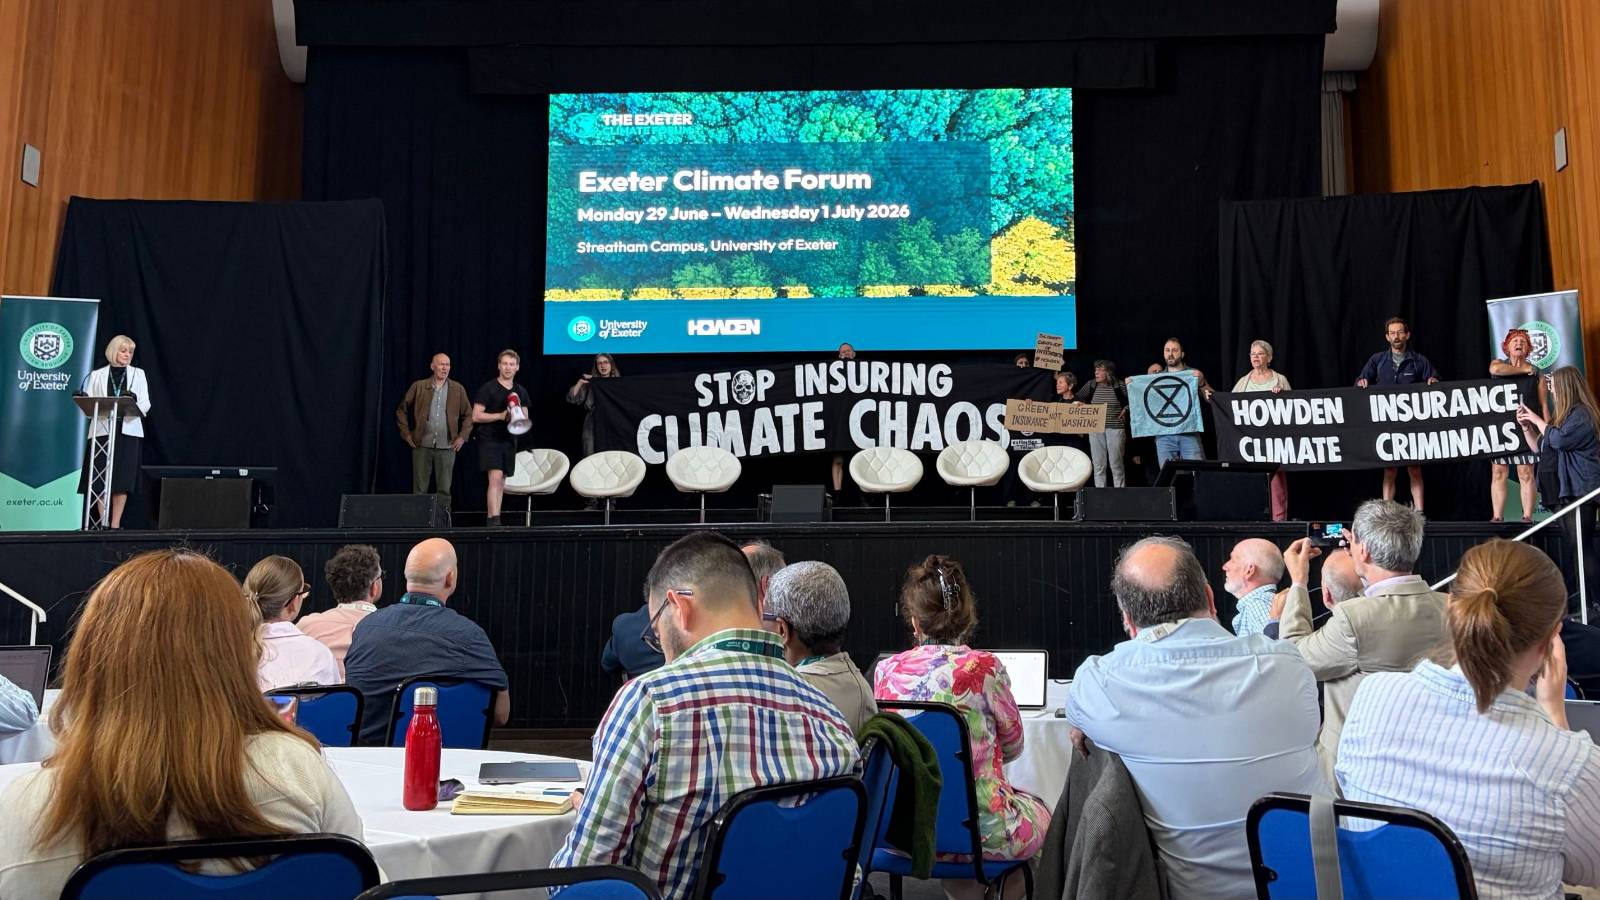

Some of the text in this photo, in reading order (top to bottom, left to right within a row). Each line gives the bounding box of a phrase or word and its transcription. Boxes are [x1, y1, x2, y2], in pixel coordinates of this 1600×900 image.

[602, 113, 693, 126] THE EXETER
[579, 169, 872, 193] Exeter Climate Forum
[577, 208, 644, 224] Monday
[646, 207, 668, 221] 29
[669, 207, 709, 221] June
[724, 205, 820, 222] Wednesday
[821, 206, 830, 219] 1
[831, 204, 866, 222] July
[867, 204, 911, 219] 2026
[577, 239, 839, 255] Streatham Campus, University of Exeter
[600, 319, 648, 330] University
[688, 319, 761, 336] HOWDEN
[599, 329, 641, 340] of Exeter
[17, 370, 71, 384] University
[693, 360, 953, 408] STOP INSURING
[19, 380, 68, 391] of Exeter
[1018, 403, 1049, 414] GREEN
[1231, 383, 1519, 427] HOWDEN INSURANCE
[1011, 414, 1049, 428] INSURANCE
[1049, 412, 1063, 421] NOT
[1062, 418, 1098, 428] WASHING
[637, 398, 1011, 464] CLIMATE CHAOS
[1239, 422, 1520, 464] CLIMATE CRIMINALS
[6, 498, 64, 506] exeter.ac.uk
